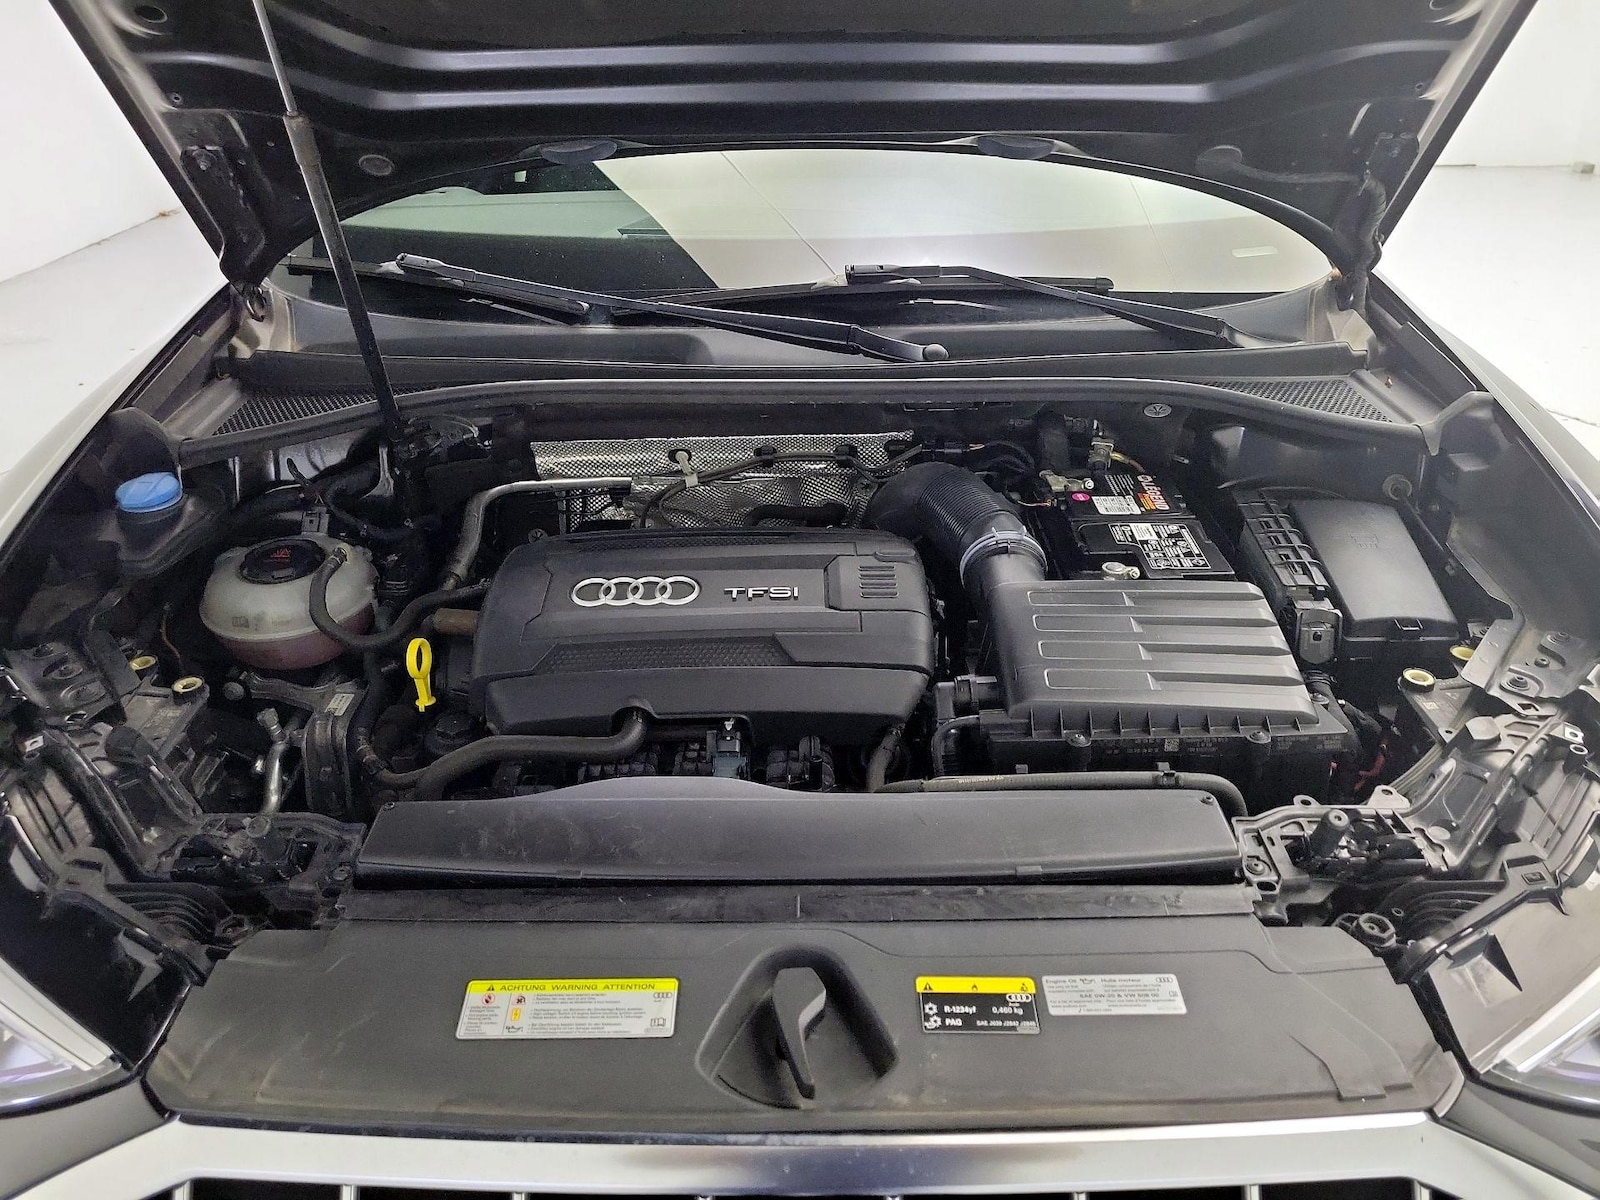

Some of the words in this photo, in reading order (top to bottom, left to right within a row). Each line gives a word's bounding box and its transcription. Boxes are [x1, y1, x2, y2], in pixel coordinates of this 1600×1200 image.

[723, 586, 799, 601] TFSI
[944, 1005, 977, 1015] R-1234yf
[1014, 1006, 1024, 1015] kg
[945, 1018, 963, 1026] PAG
